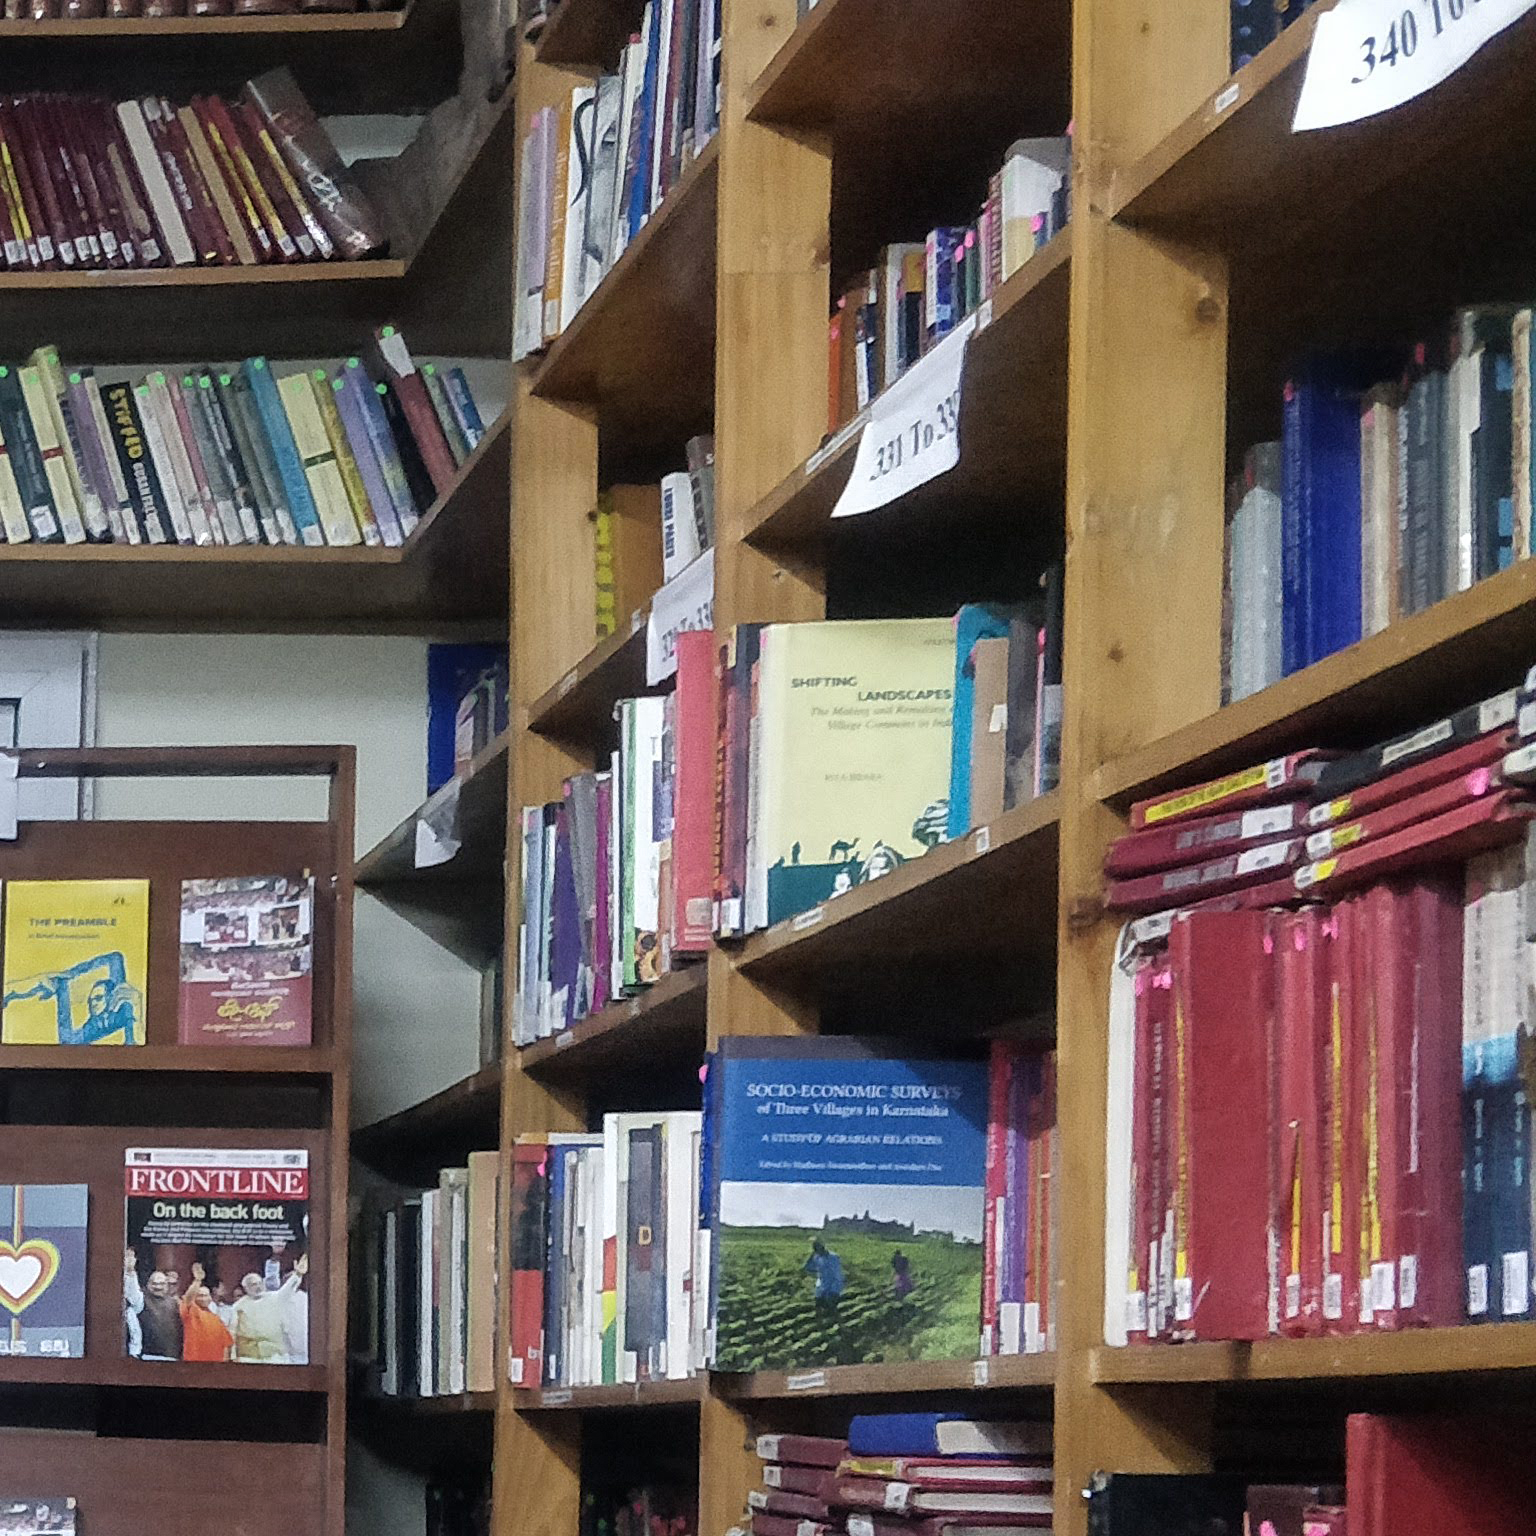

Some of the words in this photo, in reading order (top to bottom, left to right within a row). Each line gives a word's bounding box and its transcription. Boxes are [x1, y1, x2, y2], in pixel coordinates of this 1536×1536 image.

[1351, 9, 1418, 84] 340
[869, 434, 903, 481] 331
[910, 420, 934, 457] To
[791, 676, 858, 688] SHIFTING
[858, 689, 953, 702] LANDSCAPES
[30, 918, 52, 927] THE
[55, 918, 117, 927] PREAMBLE
[746, 1083, 887, 1099] SOCIO-ECONOMIC
[890, 1085, 962, 1100] SURVEYS
[756, 1102, 770, 1114] of
[774, 1102, 810, 1115] Three
[812, 1102, 864, 1118] Villages
[866, 1103, 879, 1116] in
[882, 1104, 950, 1117] Karnataka
[131, 1168, 304, 1194] FRONTLINE
[153, 1201, 177, 1218] On
[180, 1202, 206, 1218] the
[210, 1203, 248, 1220] back
[252, 1204, 284, 1220] foot
